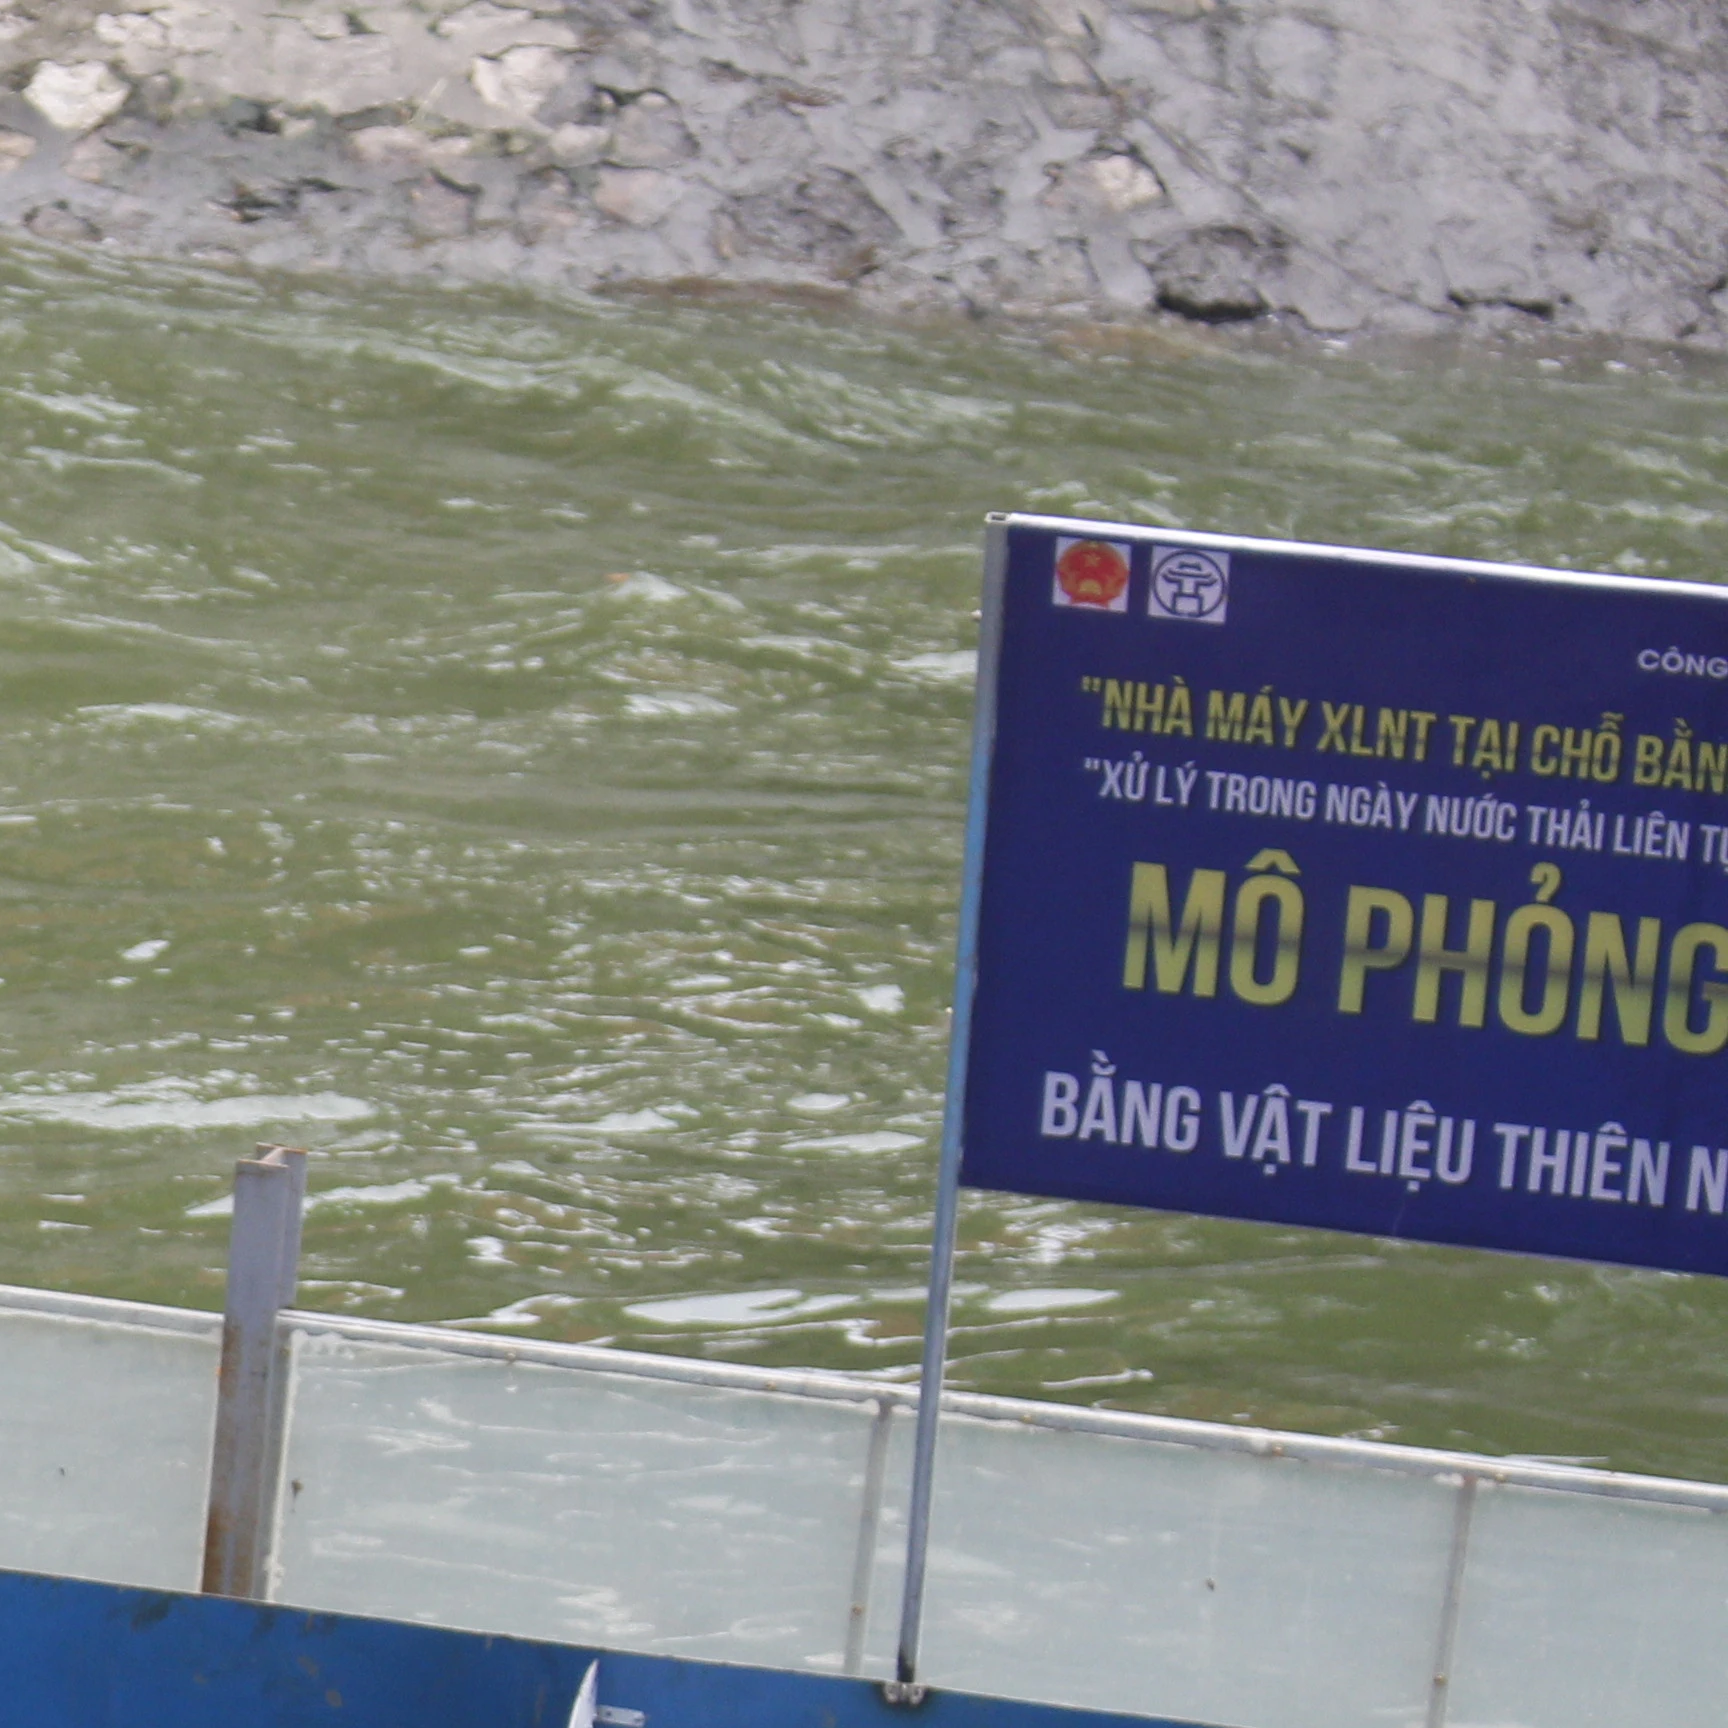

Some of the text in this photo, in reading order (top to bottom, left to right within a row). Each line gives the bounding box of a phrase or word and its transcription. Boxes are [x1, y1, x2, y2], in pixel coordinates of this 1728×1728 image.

[1637, 646, 1728, 679] CÔNG
[1205, 683, 1309, 748] MÁY
[1317, 701, 1437, 763] XLNT
[1448, 711, 1519, 780] TẠI
[1531, 711, 1623, 784] CHỖ
[1154, 758, 1198, 807] LÝ
[1205, 769, 1316, 821] TRONG
[1325, 782, 1415, 832] NGÀY
[1423, 792, 1517, 843] NƯỚC
[1526, 800, 1605, 852] THẢI
[1613, 810, 1689, 861] LIÊN
[1122, 848, 1728, 1055] MÔ PHỎNG
[1040, 1049, 1201, 1152] BẰNG
[1219, 1083, 1332, 1175] VẬT
[1344, 1100, 1476, 1192] LIỆU
[1492, 1121, 1671, 1207] THIÊN
